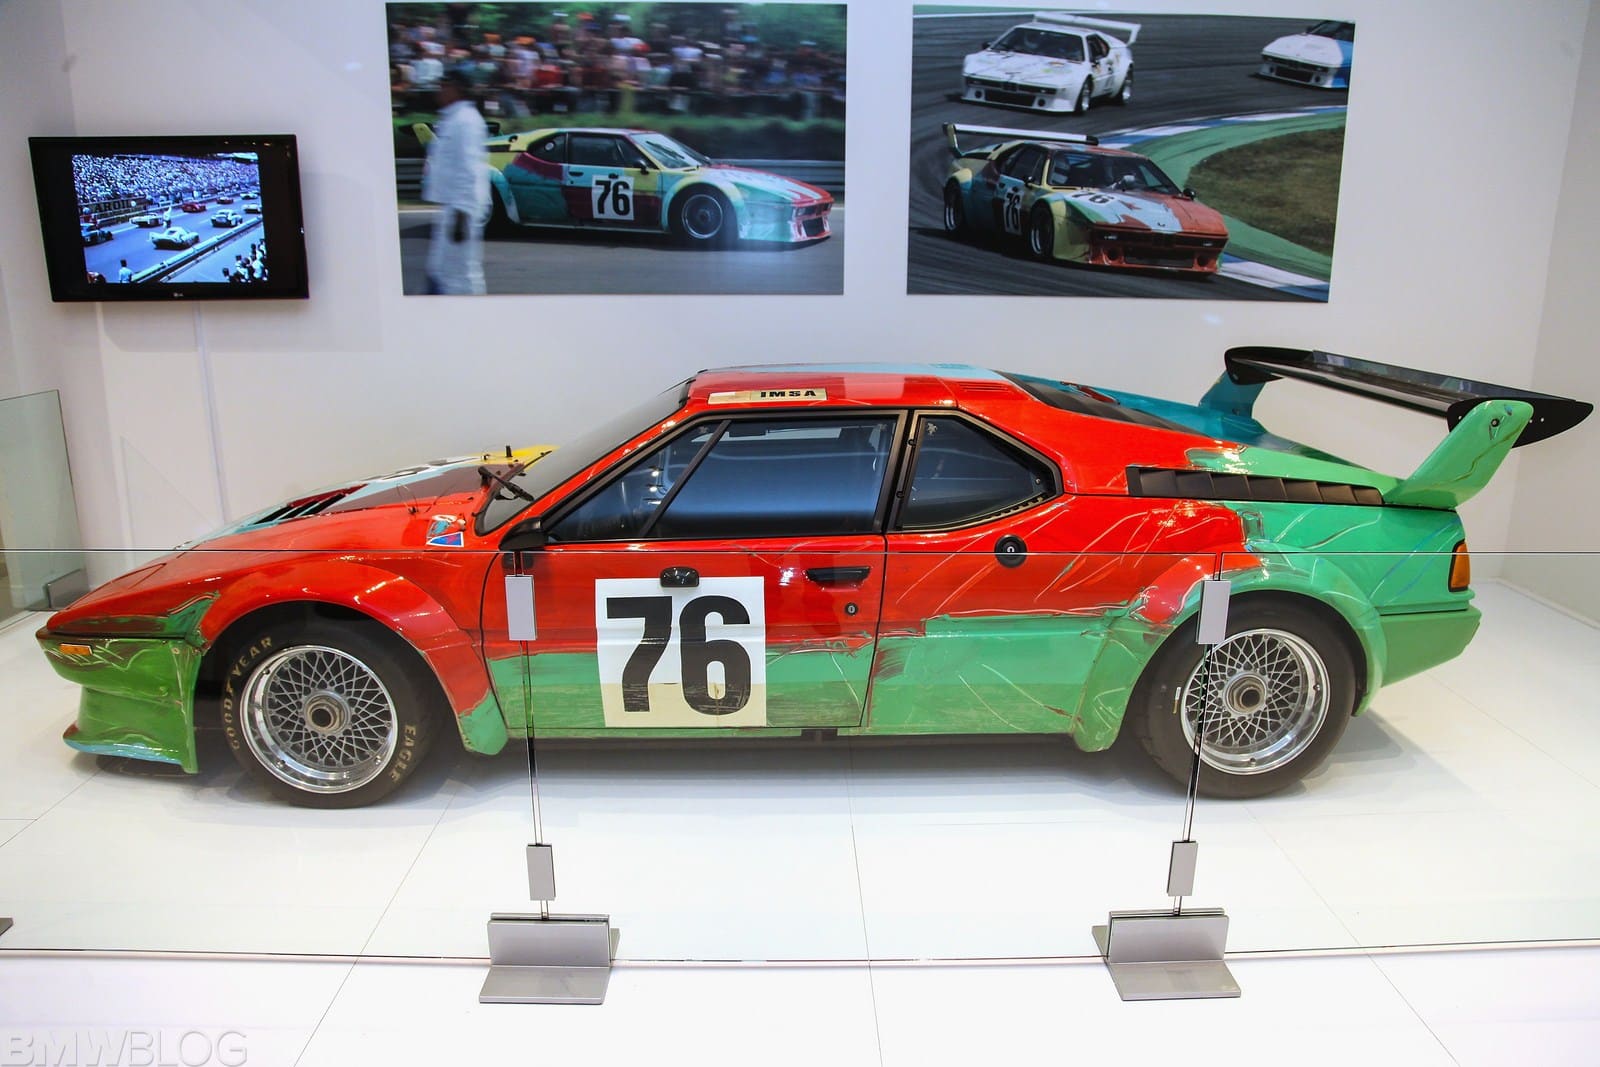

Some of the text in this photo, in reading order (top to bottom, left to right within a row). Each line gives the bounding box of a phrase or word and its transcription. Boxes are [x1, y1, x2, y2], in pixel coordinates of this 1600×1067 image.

[595, 180, 631, 216] 76
[760, 390, 816, 398] IMSA
[606, 595, 752, 716] 76
[390, 724, 417, 783] EAGLE
